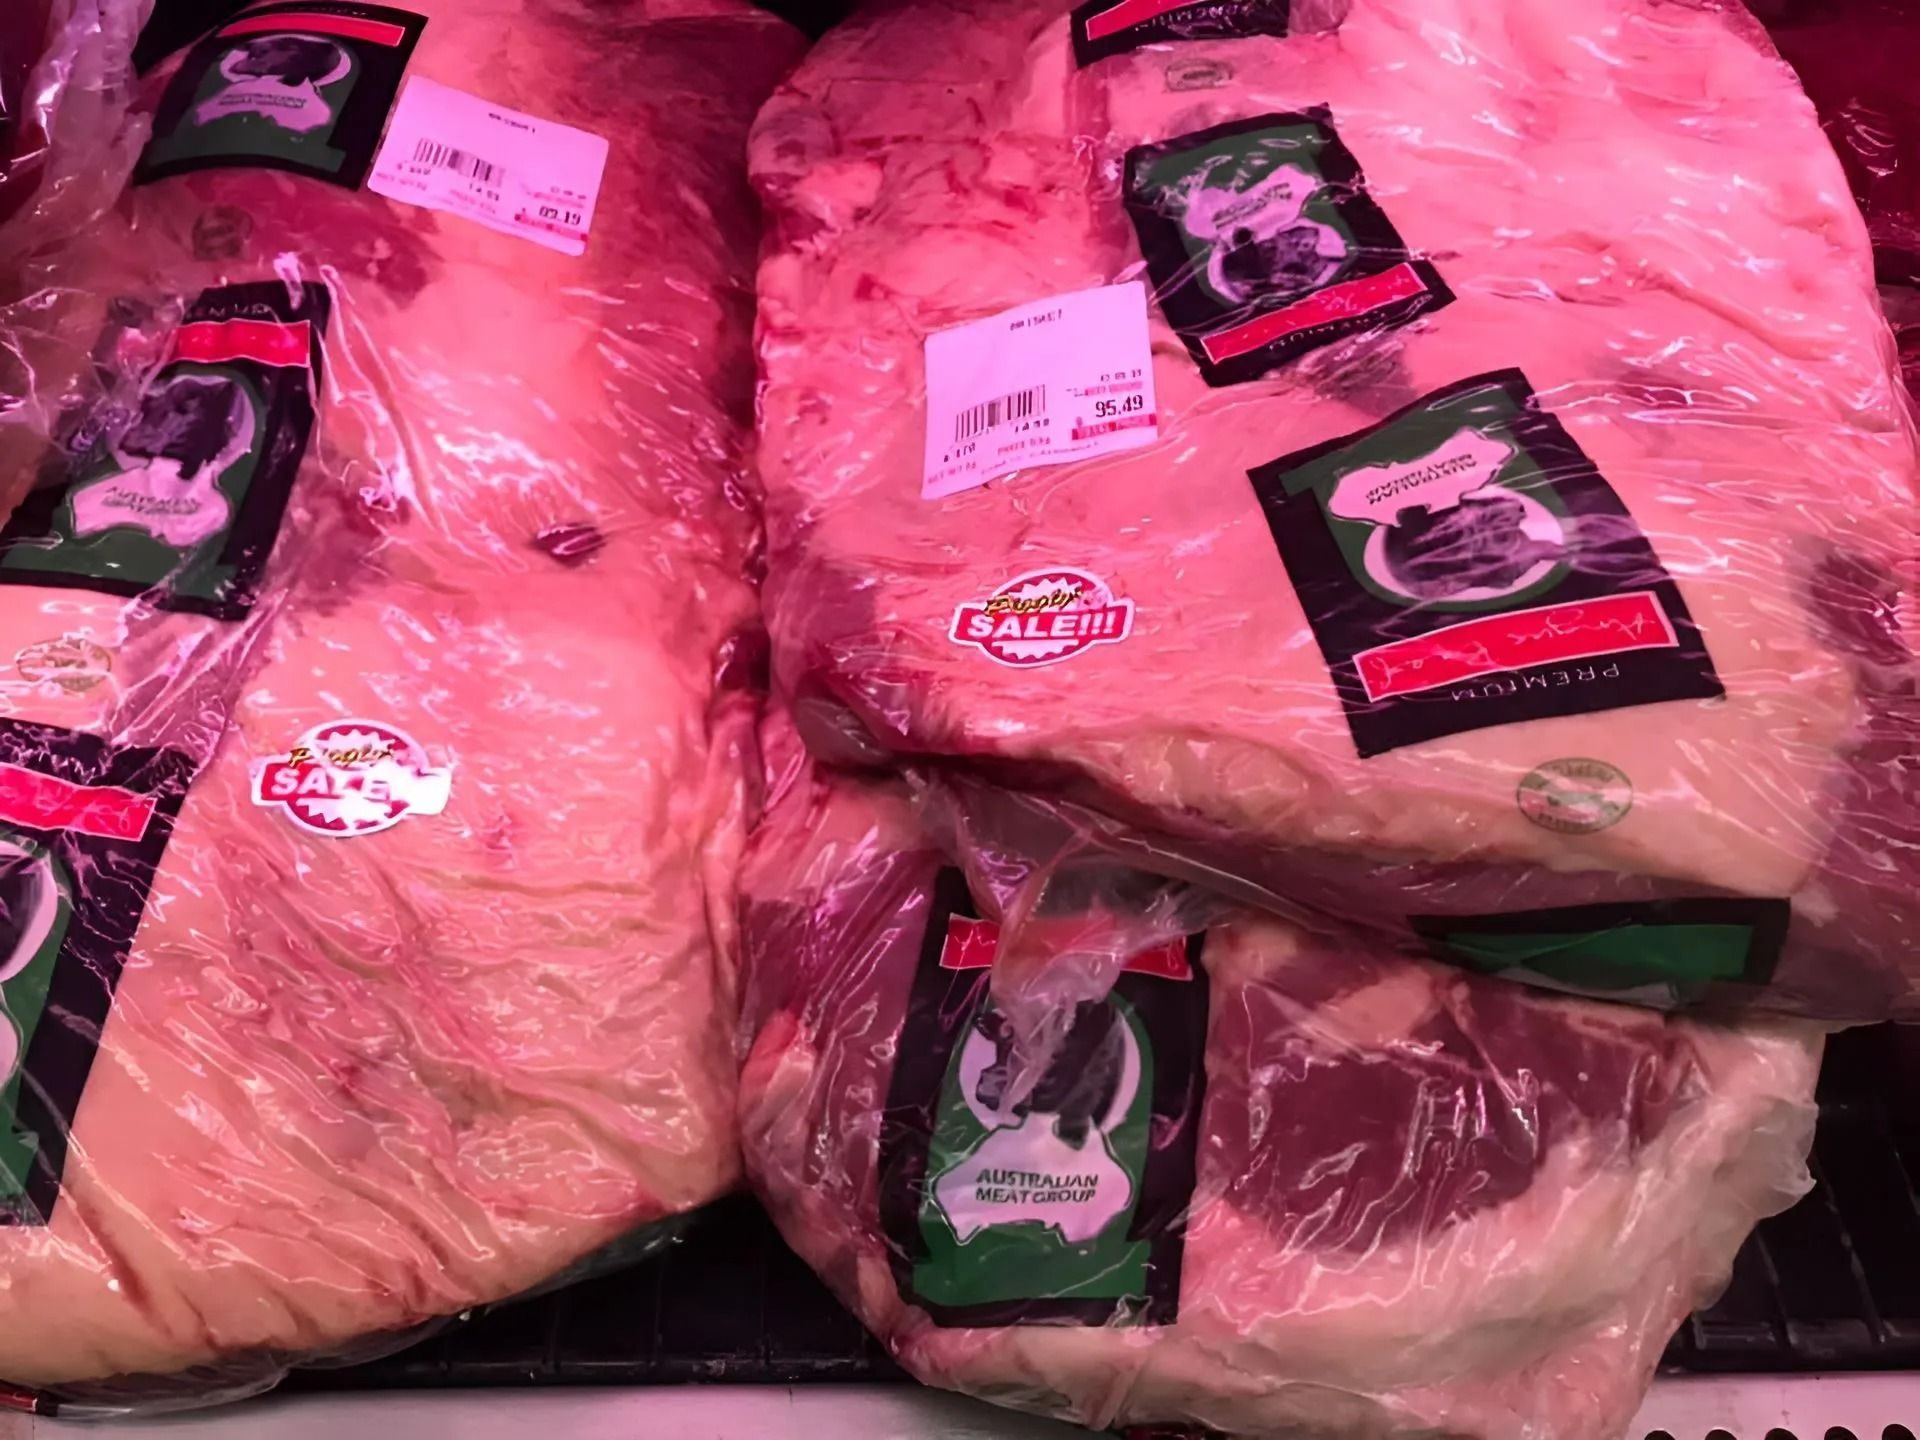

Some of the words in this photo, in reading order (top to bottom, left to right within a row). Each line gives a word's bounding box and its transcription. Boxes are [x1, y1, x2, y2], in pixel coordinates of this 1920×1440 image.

[1094, 394, 1144, 418] 95.49
[966, 611, 1117, 638] SALE!!!
[1451, 662, 1621, 701] PREMIUM
[975, 1168, 1099, 1189] AUSTRALIAN
[975, 1187, 1031, 1204] MEAT
[1032, 1188, 1098, 1204] GROUP
